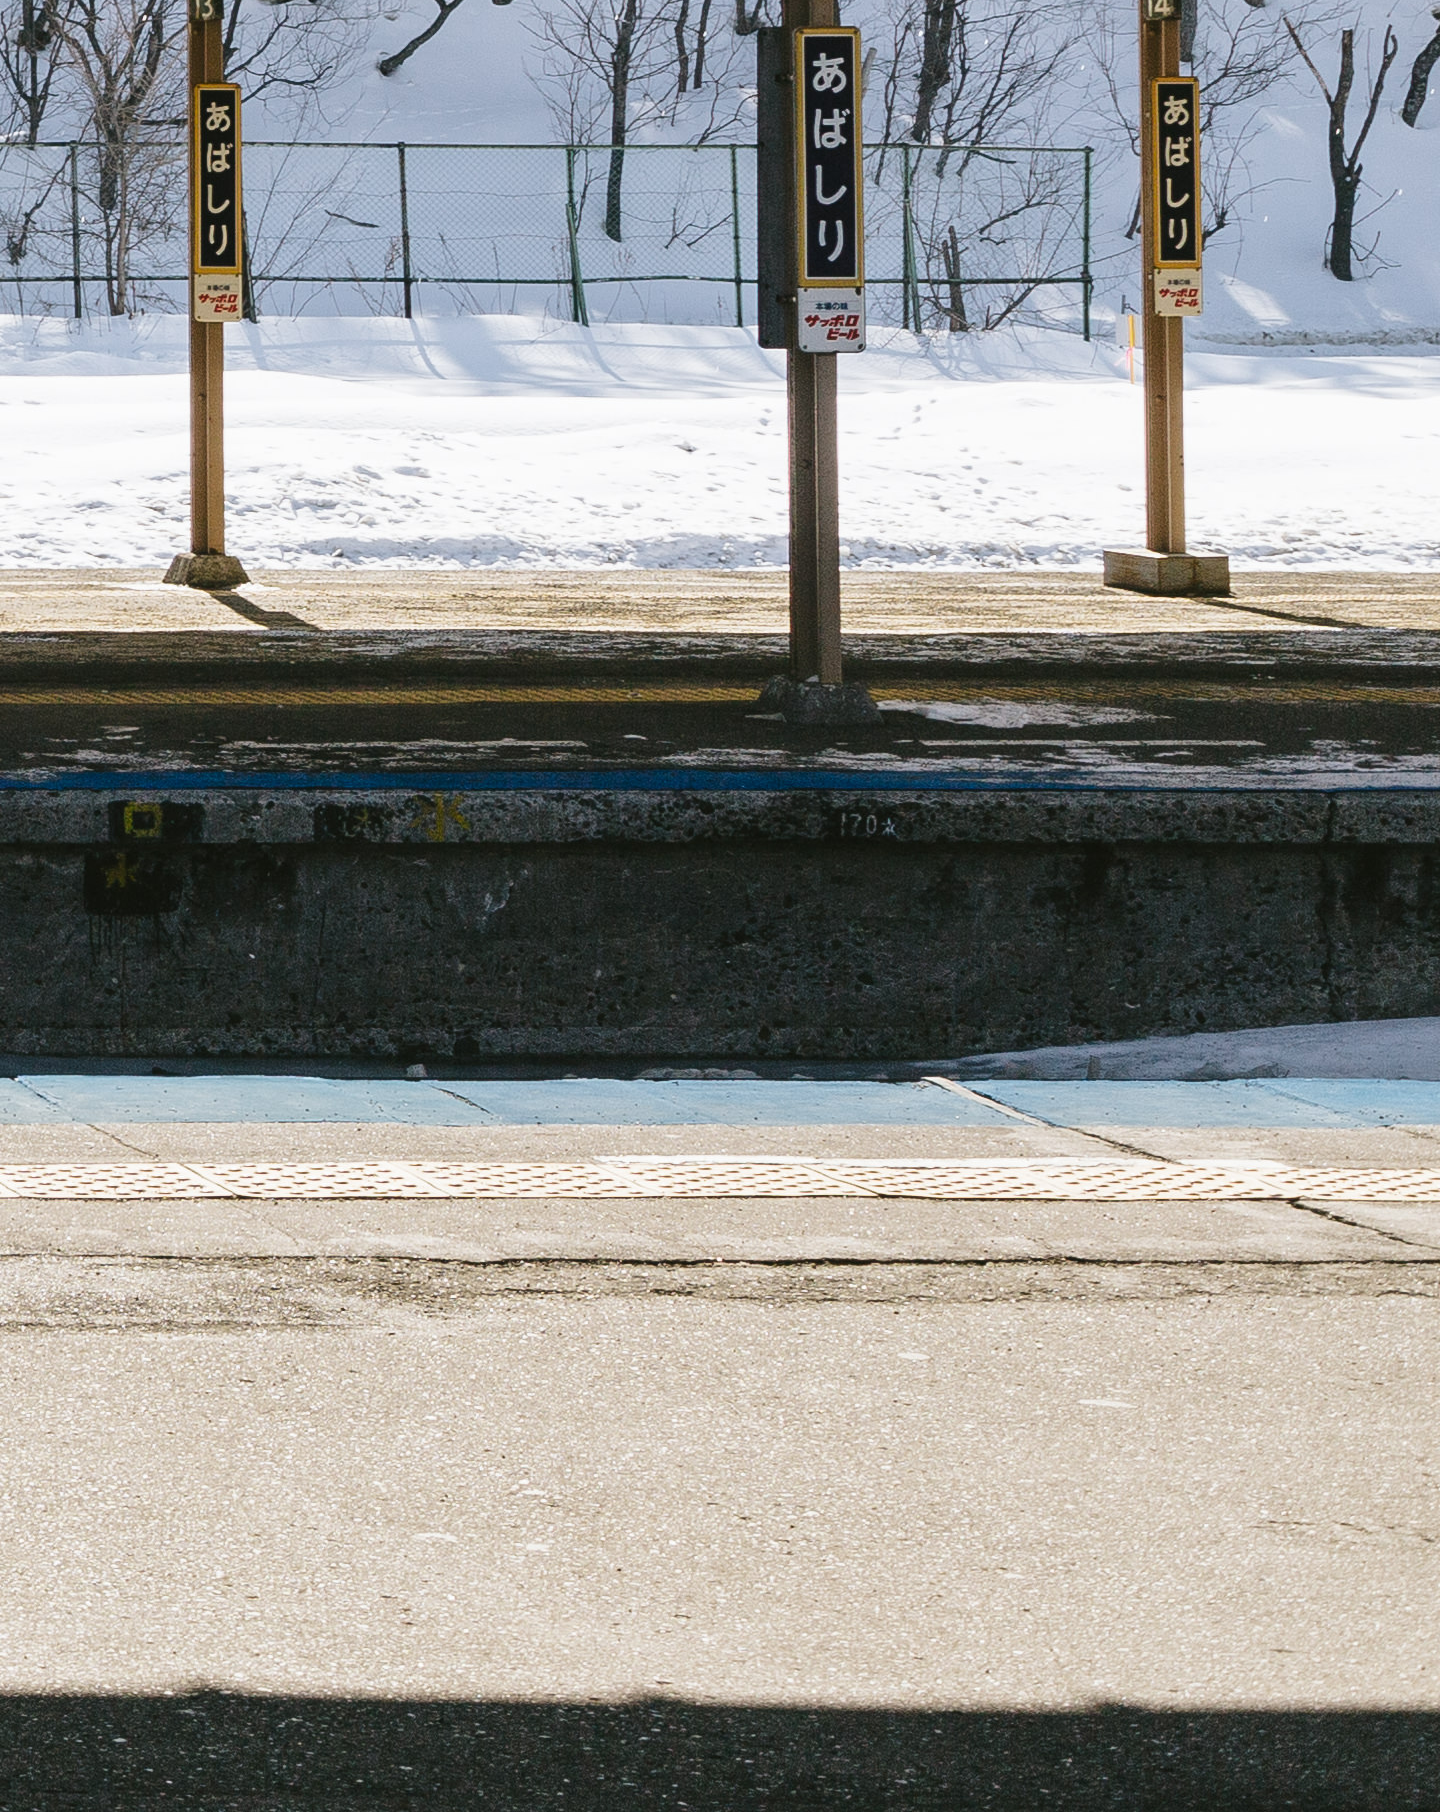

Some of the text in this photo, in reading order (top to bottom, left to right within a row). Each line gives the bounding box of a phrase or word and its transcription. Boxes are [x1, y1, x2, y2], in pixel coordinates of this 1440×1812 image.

[811, 52, 850, 263] あばしり
[205, 101, 233, 257] あばしり
[1162, 94, 1191, 251] あばしり
[198, 293, 239, 304] サッポロ
[1159, 287, 1199, 298] サッポロ
[213, 303, 239, 313] ビール
[1174, 298, 1200, 308] ビール
[804, 313, 861, 328] サッポロ
[825, 327, 861, 341] ビール
